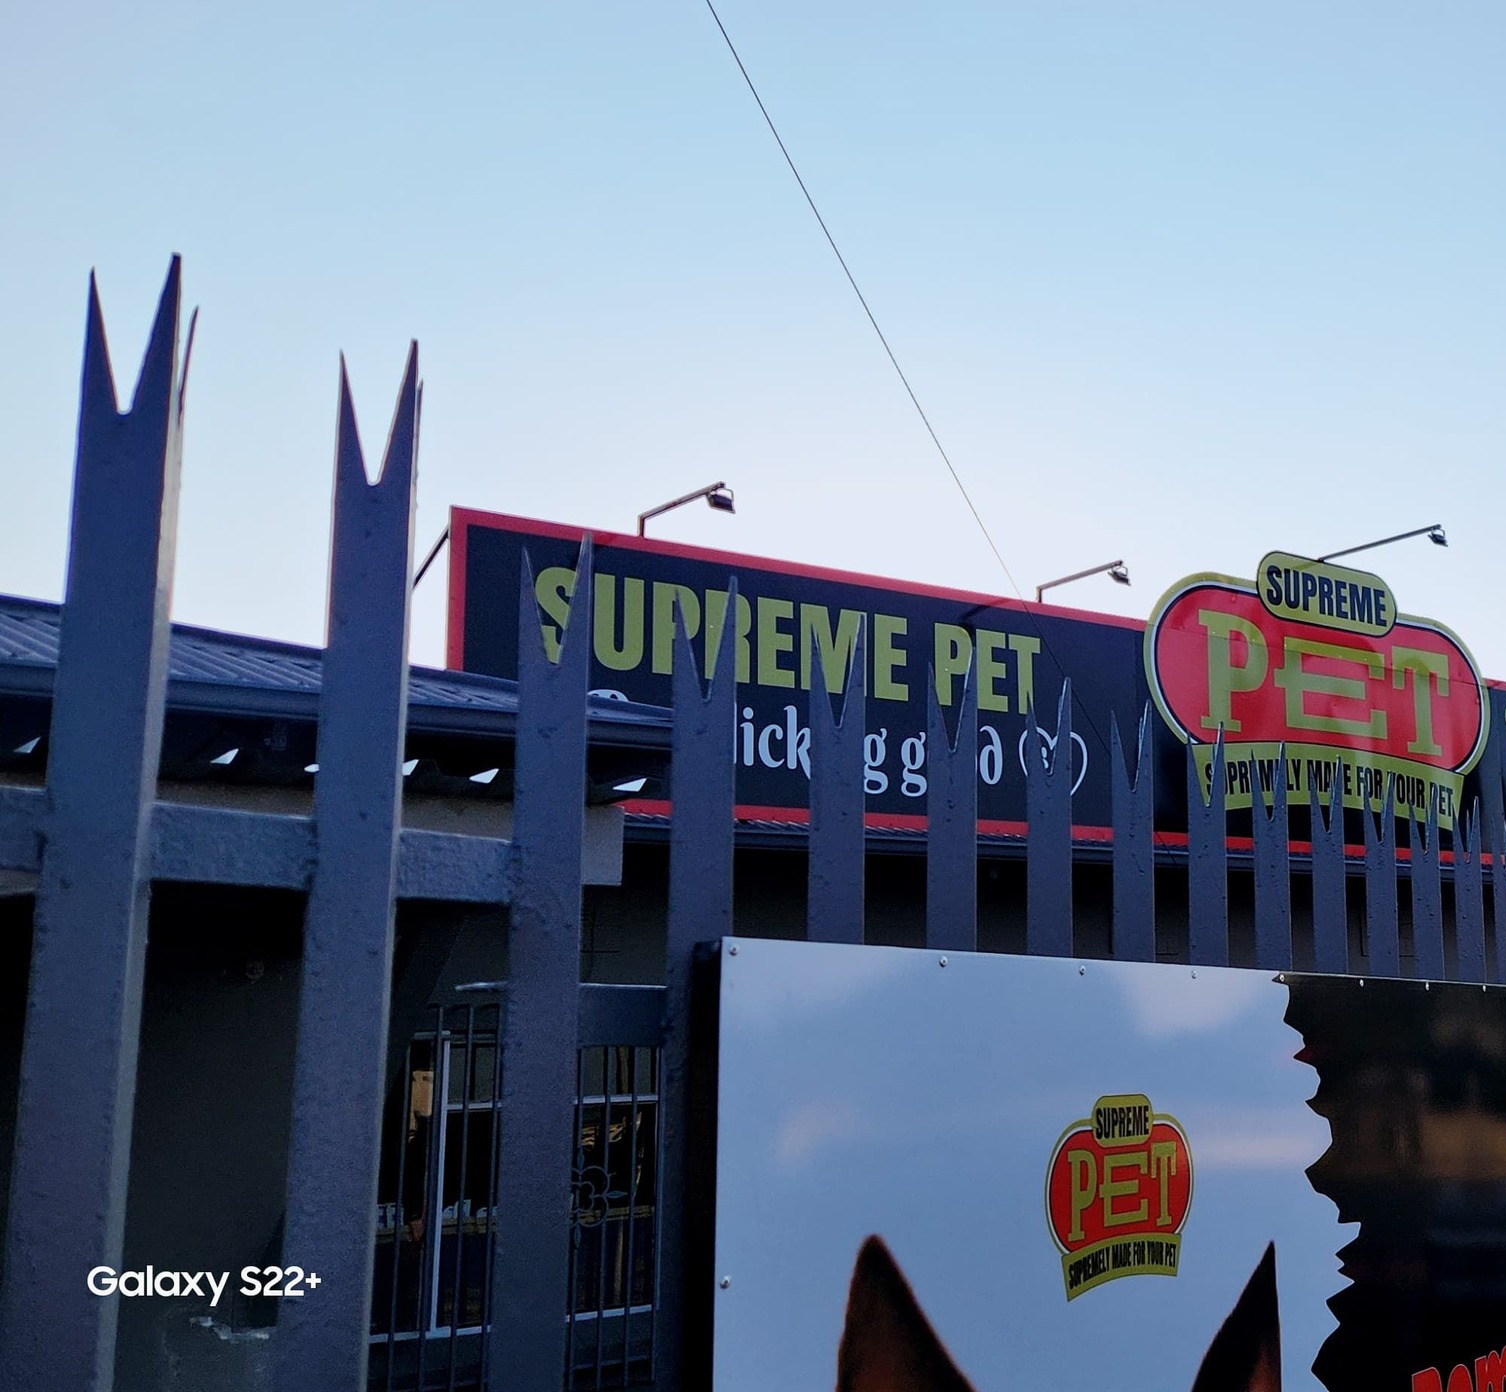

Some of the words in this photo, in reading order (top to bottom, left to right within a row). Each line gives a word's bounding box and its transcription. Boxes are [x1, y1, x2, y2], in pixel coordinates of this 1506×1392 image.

[1266, 565, 1388, 627] SUPREME
[535, 566, 910, 702] SUPREME
[934, 623, 1041, 714] PET
[1198, 608, 1450, 757] PET
[901, 725, 1003, 797] gd
[1096, 1104, 1150, 1140] SUPREME
[1067, 1141, 1177, 1242] PET
[1068, 1246, 1111, 1290] SUPREMELY
[1112, 1241, 1132, 1270] MADE
[1133, 1240, 1146, 1266] FOR
[1146, 1240, 1165, 1267] YOUR
[1165, 1242, 1177, 1269] PET
